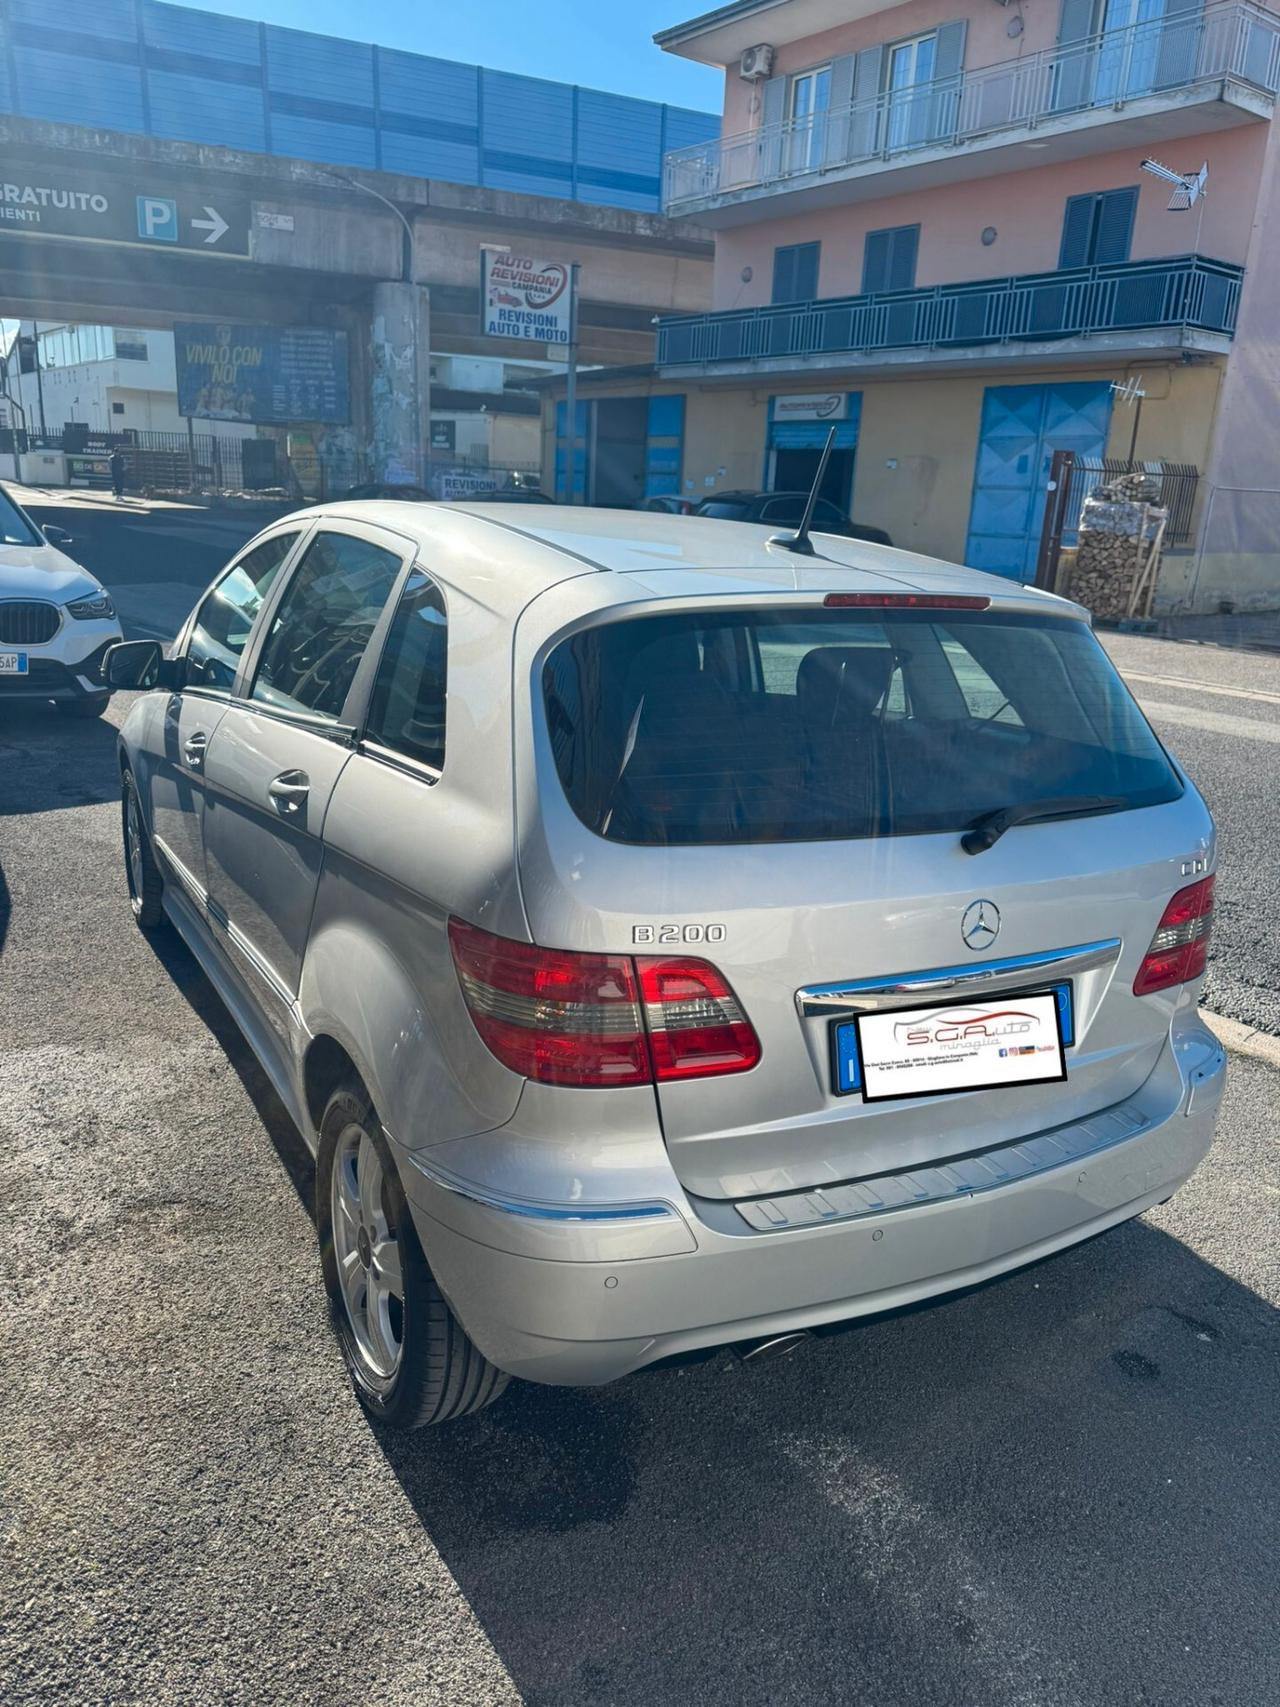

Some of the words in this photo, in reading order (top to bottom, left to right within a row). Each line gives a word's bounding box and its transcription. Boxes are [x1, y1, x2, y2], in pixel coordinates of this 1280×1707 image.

[0, 183, 108, 213] RATUITO
[145, 200, 171, 235] P
[494, 255, 533, 270] AUTO
[490, 267, 560, 288] REVISIONI
[511, 281, 552, 295] CAMPANIA
[498, 308, 558, 329] REVISIONI
[488, 321, 520, 337] AUTO
[524, 325, 531, 338] E
[534, 326, 568, 342] MOTO
[232, 345, 262, 368] CON
[212, 362, 238, 385] NOI
[444, 479, 496, 491] REVISIONI
